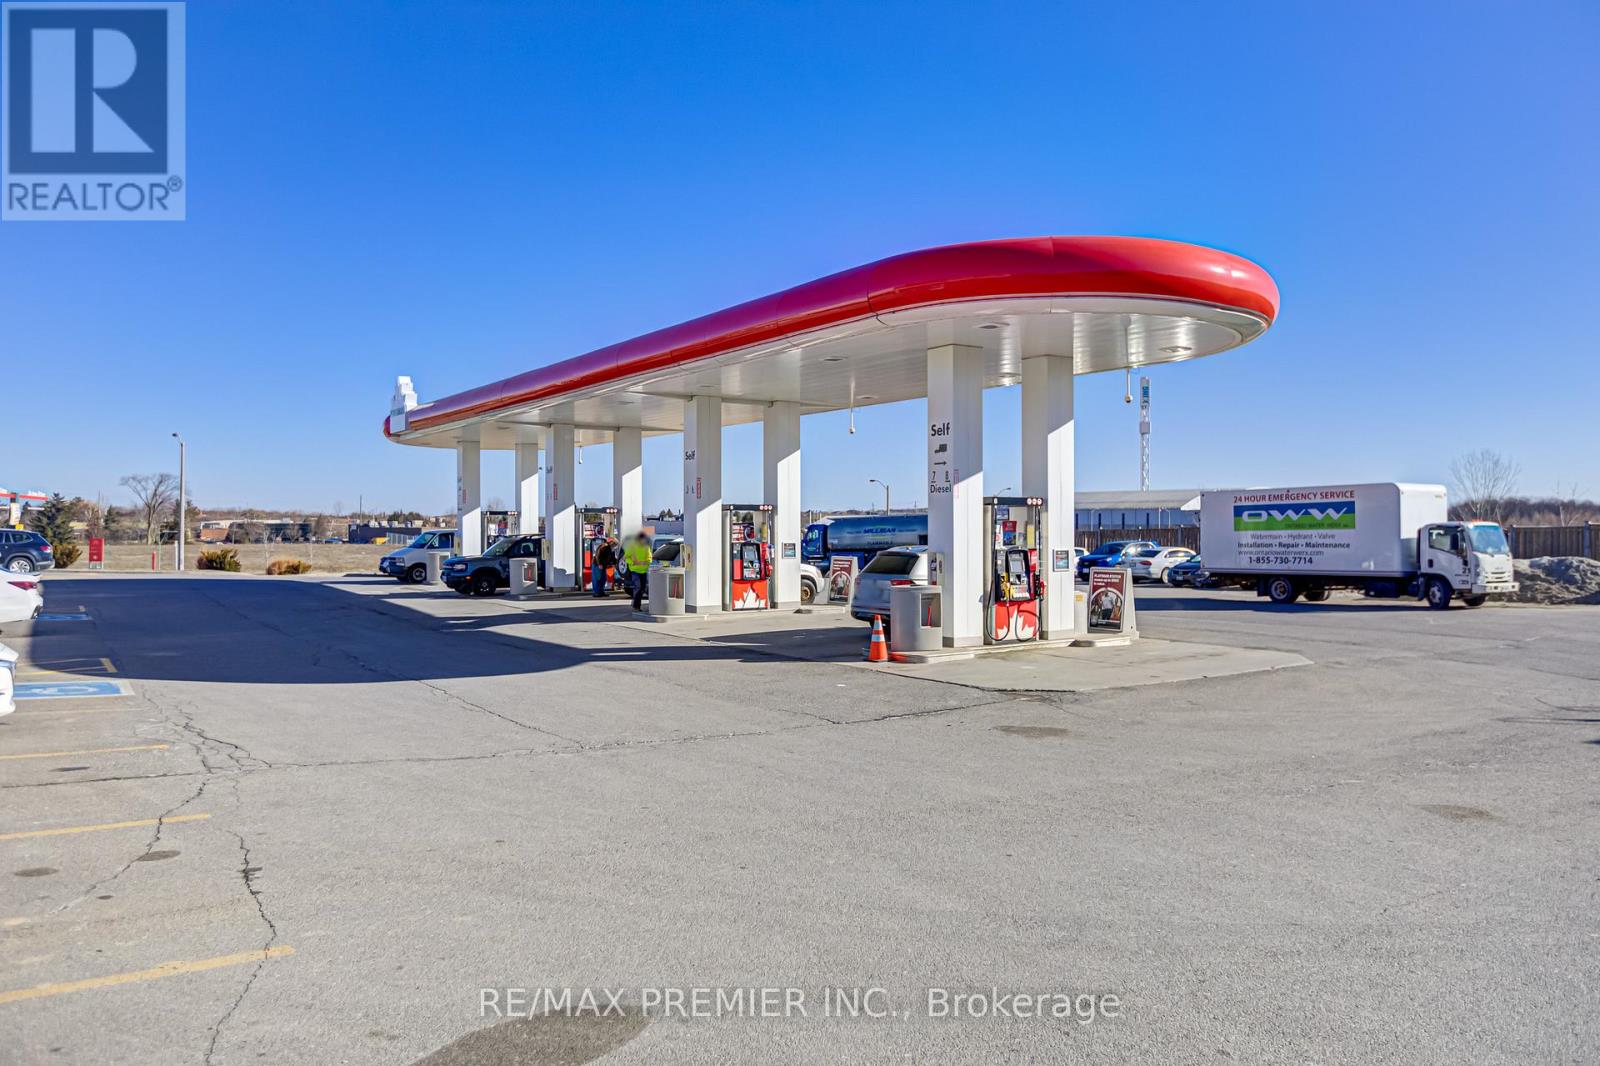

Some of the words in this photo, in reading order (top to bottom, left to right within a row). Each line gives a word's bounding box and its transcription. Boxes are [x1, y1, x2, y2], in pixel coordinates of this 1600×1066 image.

[930, 422, 950, 437] Self
[930, 484, 952, 493] Diesel
[1233, 495, 1243, 503] 24
[1244, 494, 1266, 502] HOUR
[1268, 492, 1318, 502] EMERGENCY
[1319, 490, 1355, 500] SERVICE
[1287, 533, 1314, 541] Hydrant
[1278, 542, 1300, 550] Repair
[1305, 541, 1351, 549] Maintenance
[1248, 556, 1313, 565] 1-855-730-7714
